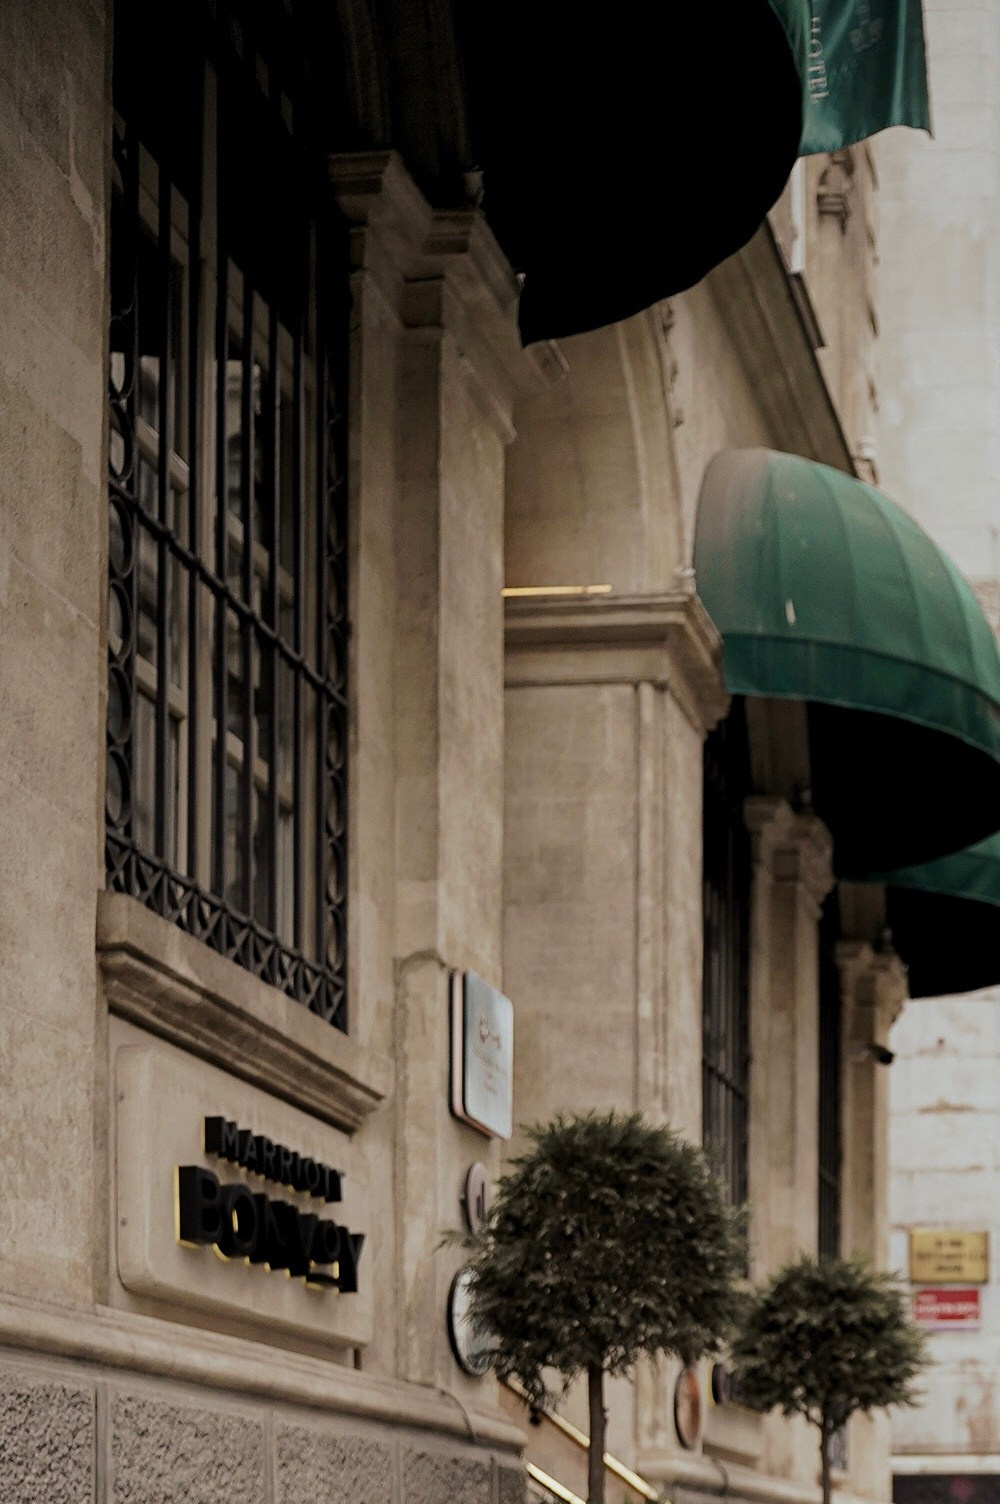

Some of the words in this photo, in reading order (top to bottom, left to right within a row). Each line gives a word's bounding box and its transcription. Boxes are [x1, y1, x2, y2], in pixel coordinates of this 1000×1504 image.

[808, 16, 829, 104] HOTEL
[204, 1116, 345, 1203] MARRIOTT
[175, 1165, 366, 1293] BONVOY
